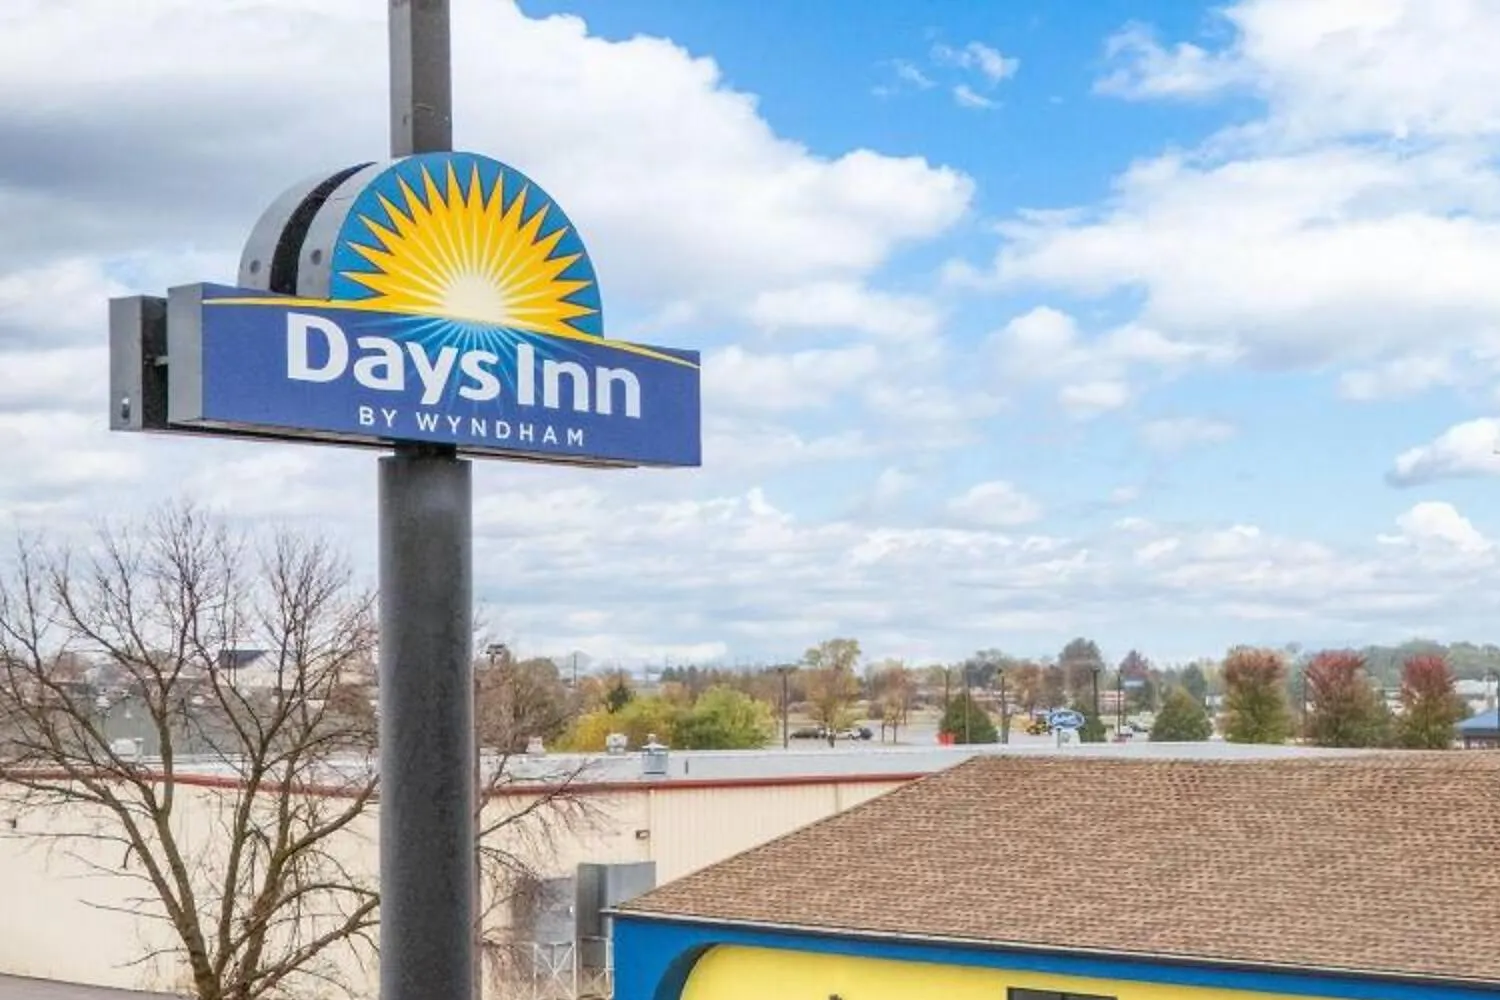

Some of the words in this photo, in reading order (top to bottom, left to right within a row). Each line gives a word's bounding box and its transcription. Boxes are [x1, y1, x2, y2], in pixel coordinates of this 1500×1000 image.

[286, 313, 501, 404] Days
[517, 344, 641, 419] Inn
[359, 407, 398, 428] BY
[416, 412, 584, 447] WYNDHAM
